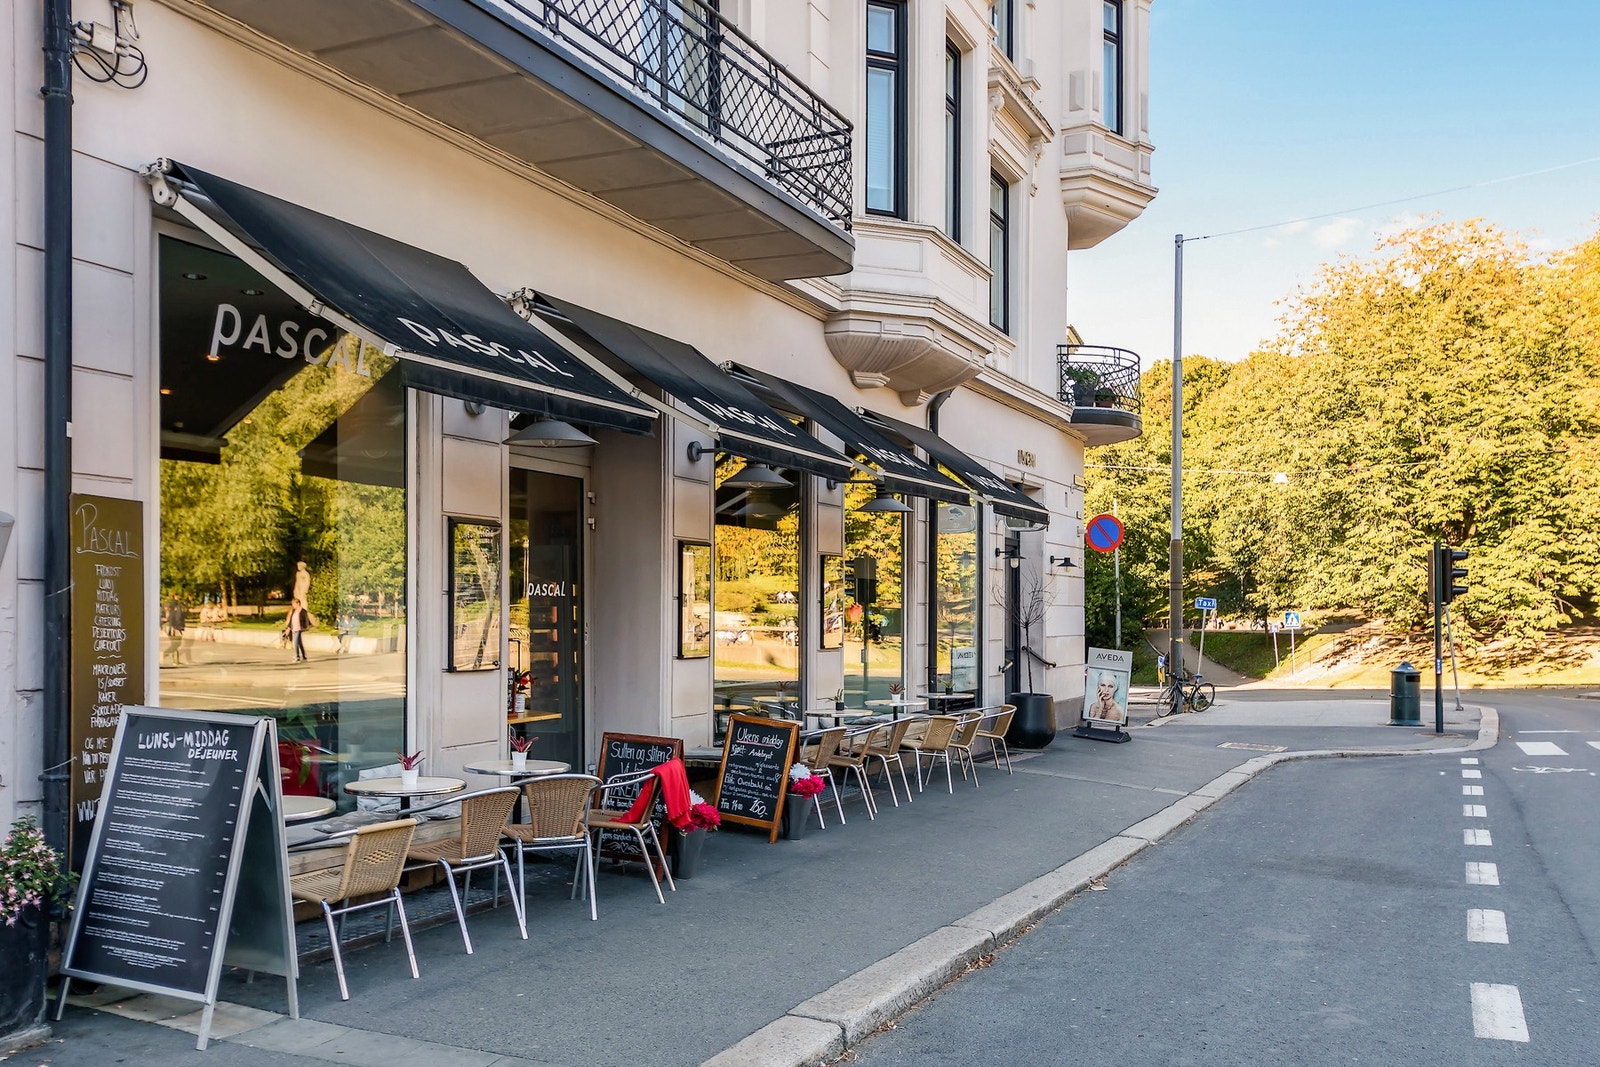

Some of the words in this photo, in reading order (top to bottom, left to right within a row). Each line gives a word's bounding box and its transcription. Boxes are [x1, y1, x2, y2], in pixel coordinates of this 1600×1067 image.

[209, 303, 371, 378] PASCAL
[397, 317, 575, 378] PASCAL
[692, 396, 797, 437] PASCAL
[75, 503, 137, 554] PASCAL
[1198, 599, 1215, 607] Taxi
[1095, 653, 1125, 662] AVEDA
[737, 727, 759, 743] Ukens
[610, 741, 635, 759] Sulten
[636, 748, 646, 765] og
